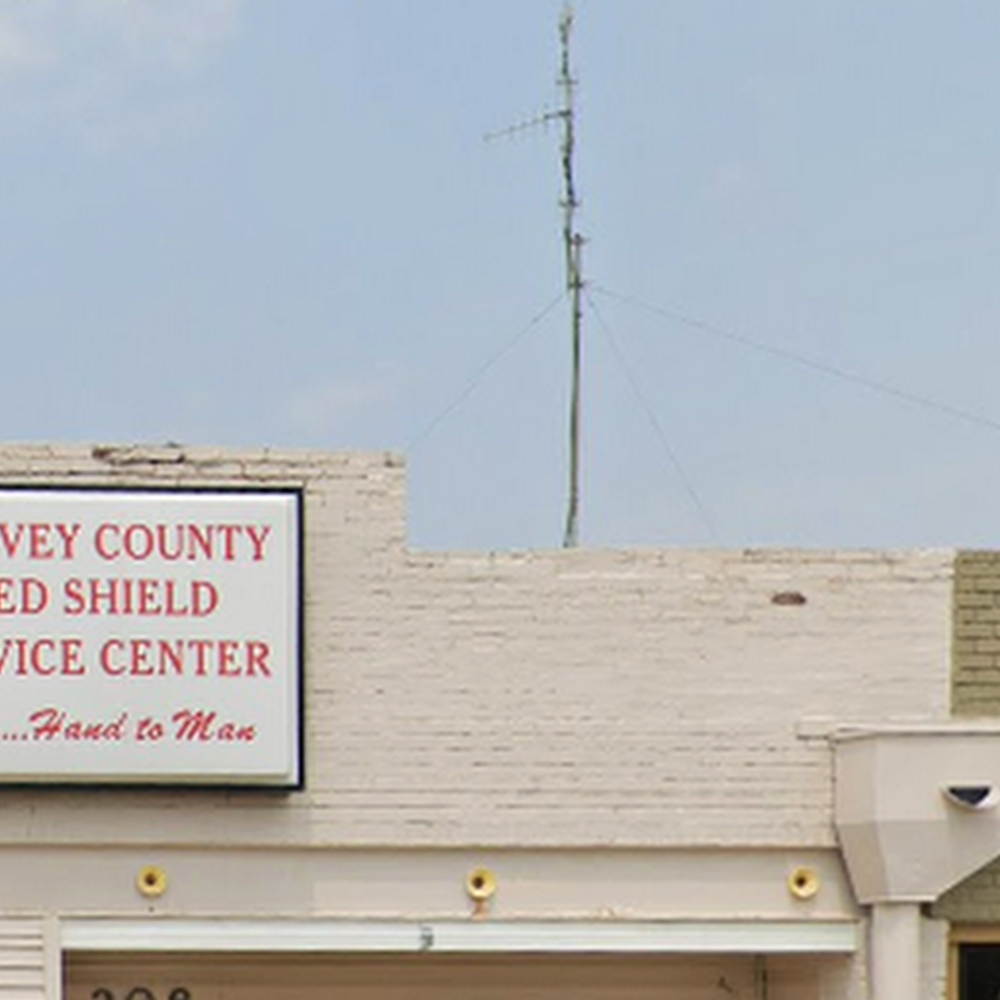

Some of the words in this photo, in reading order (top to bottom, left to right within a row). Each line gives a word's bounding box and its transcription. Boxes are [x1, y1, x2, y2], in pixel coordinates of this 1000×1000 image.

[95, 522, 273, 562] COUNTY
[64, 578, 220, 618] SHIELD
[100, 639, 273, 679] CENTER
[135, 717, 165, 743] to
[172, 709, 256, 743] Man
